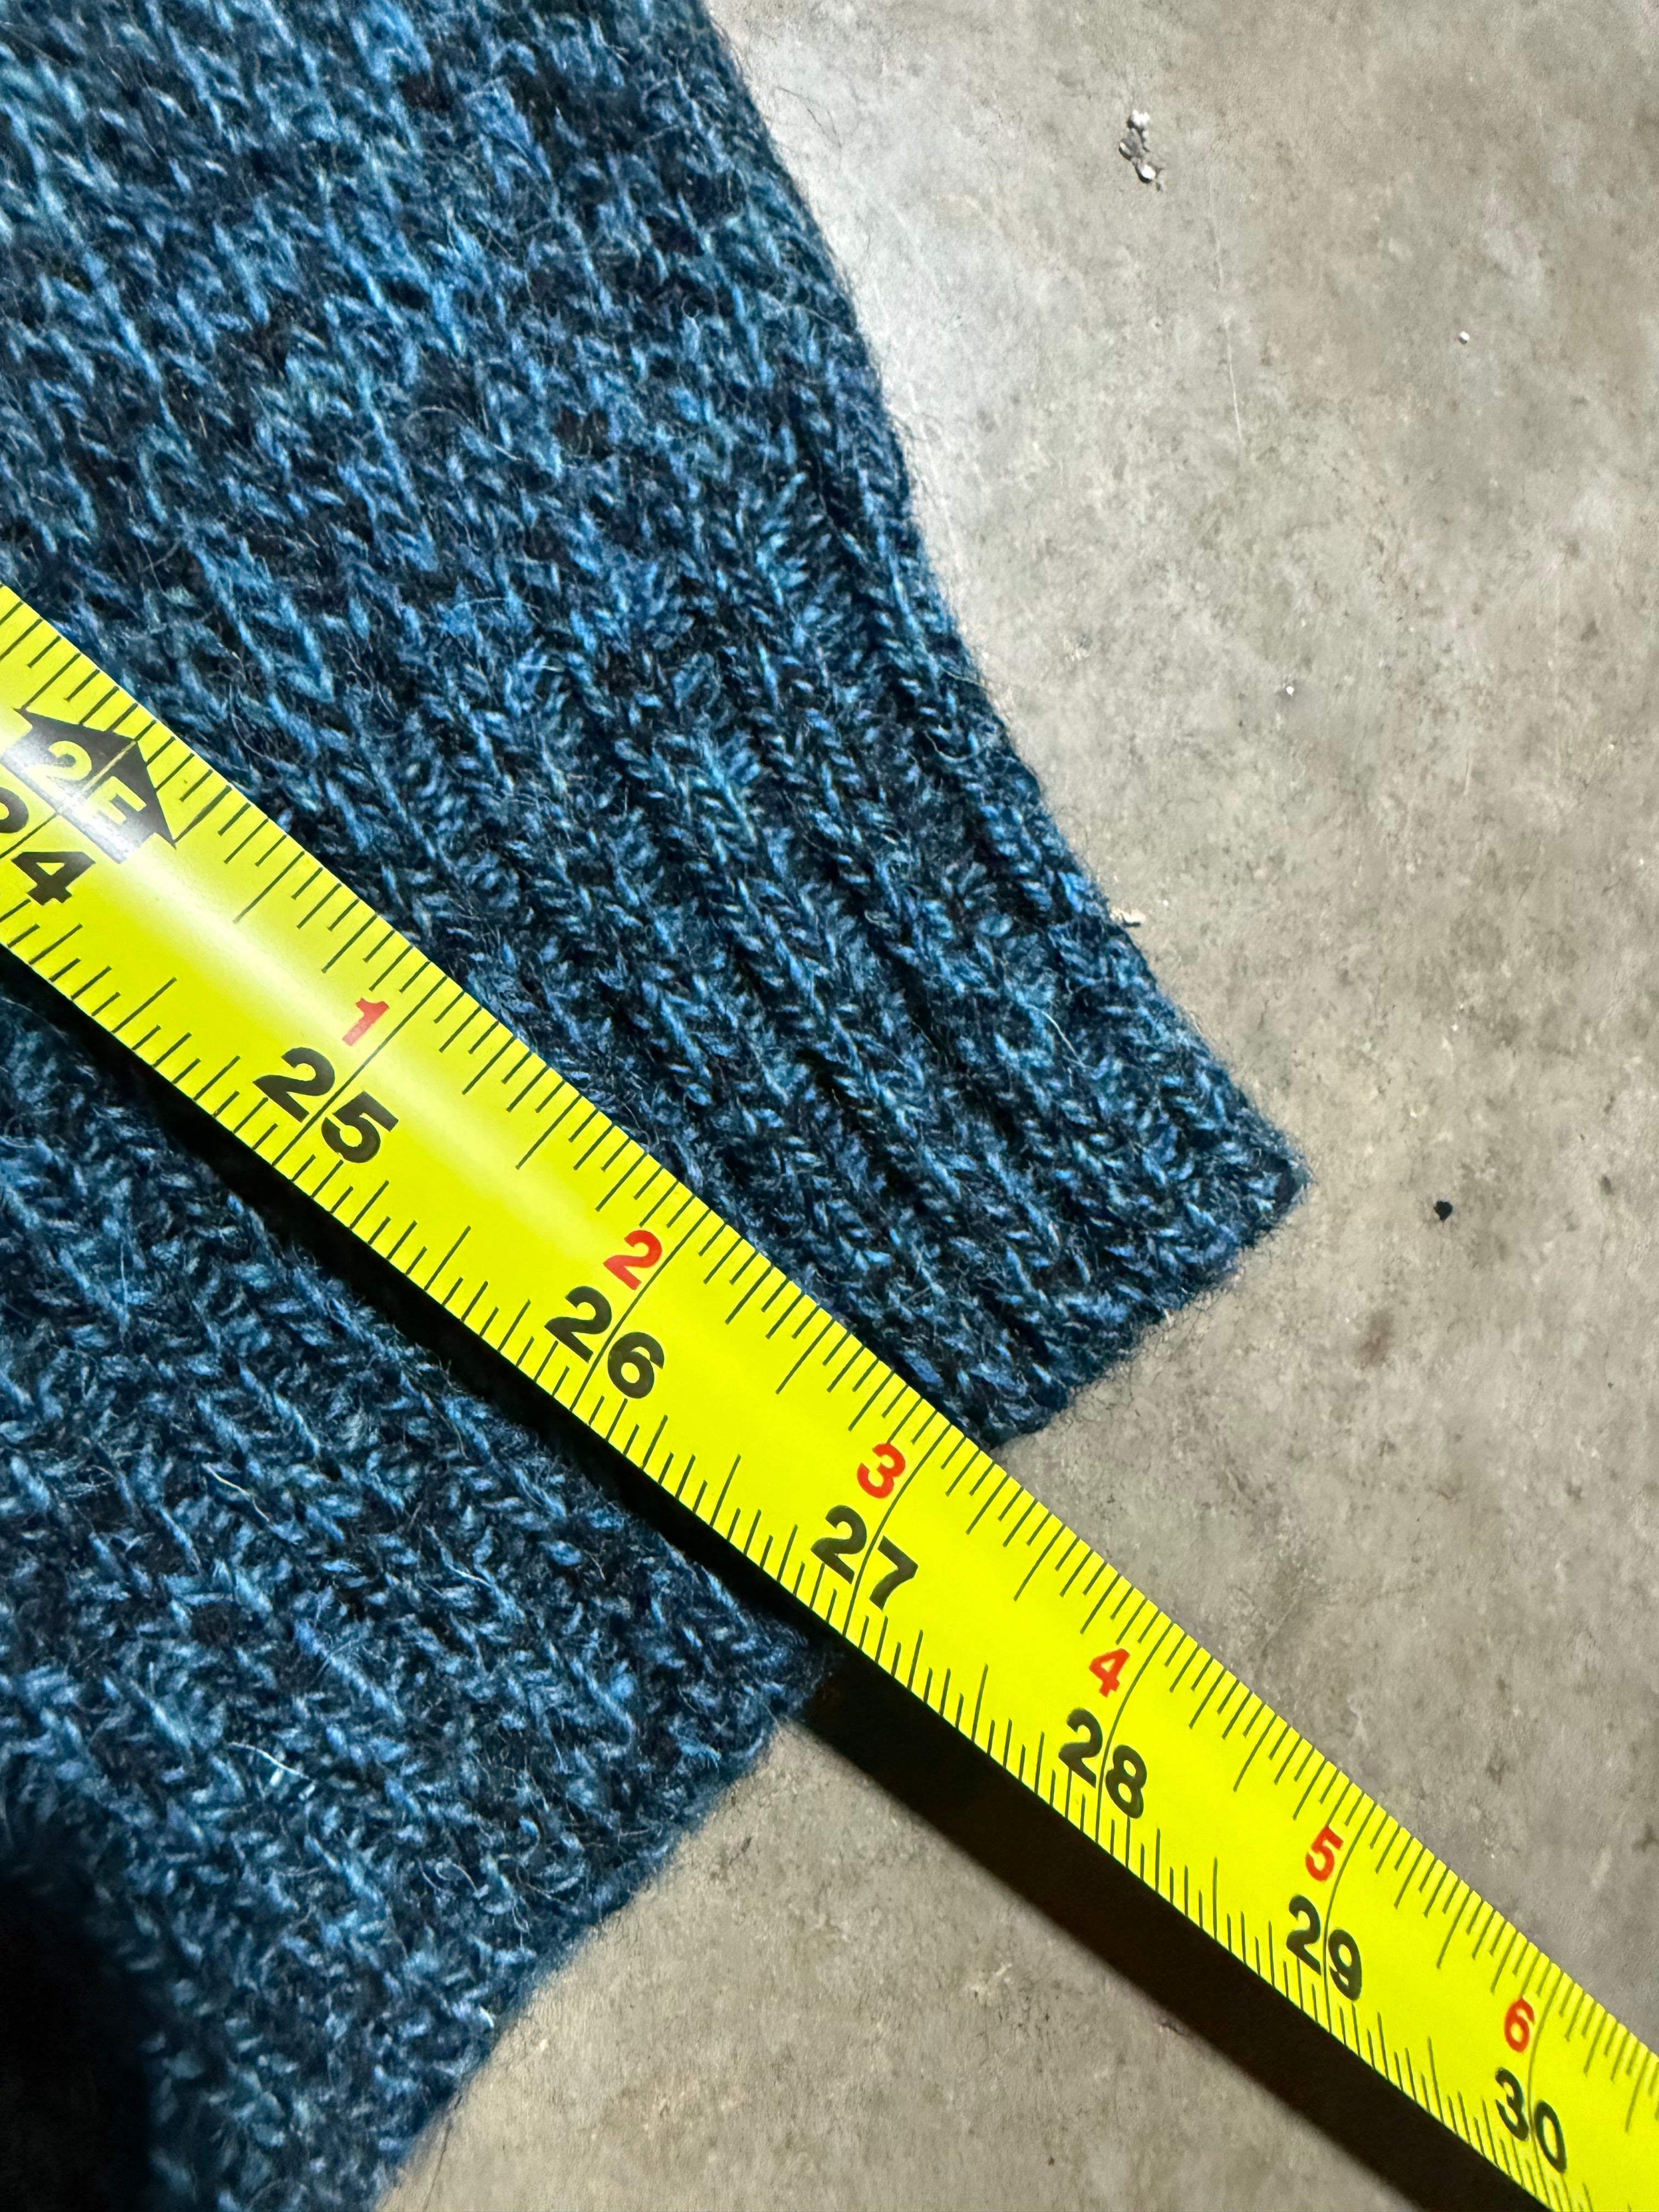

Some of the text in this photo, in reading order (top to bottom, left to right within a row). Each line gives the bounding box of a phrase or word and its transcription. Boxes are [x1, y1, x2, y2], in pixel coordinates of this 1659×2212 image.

[342, 997, 389, 1046] 1
[253, 1047, 399, 1164] 25
[603, 1229, 663, 1290] 2
[544, 1285, 665, 1400] 26
[856, 1442, 906, 1499] 3
[810, 1504, 919, 1612] 27
[1089, 1648, 1131, 1698] 4
[1058, 1708, 1148, 1819] 28
[1305, 1825, 1344, 1882] 5
[1285, 1894, 1363, 2001] 29
[1504, 1997, 1535, 2052] 6
[1494, 2067, 1567, 2174] 30
